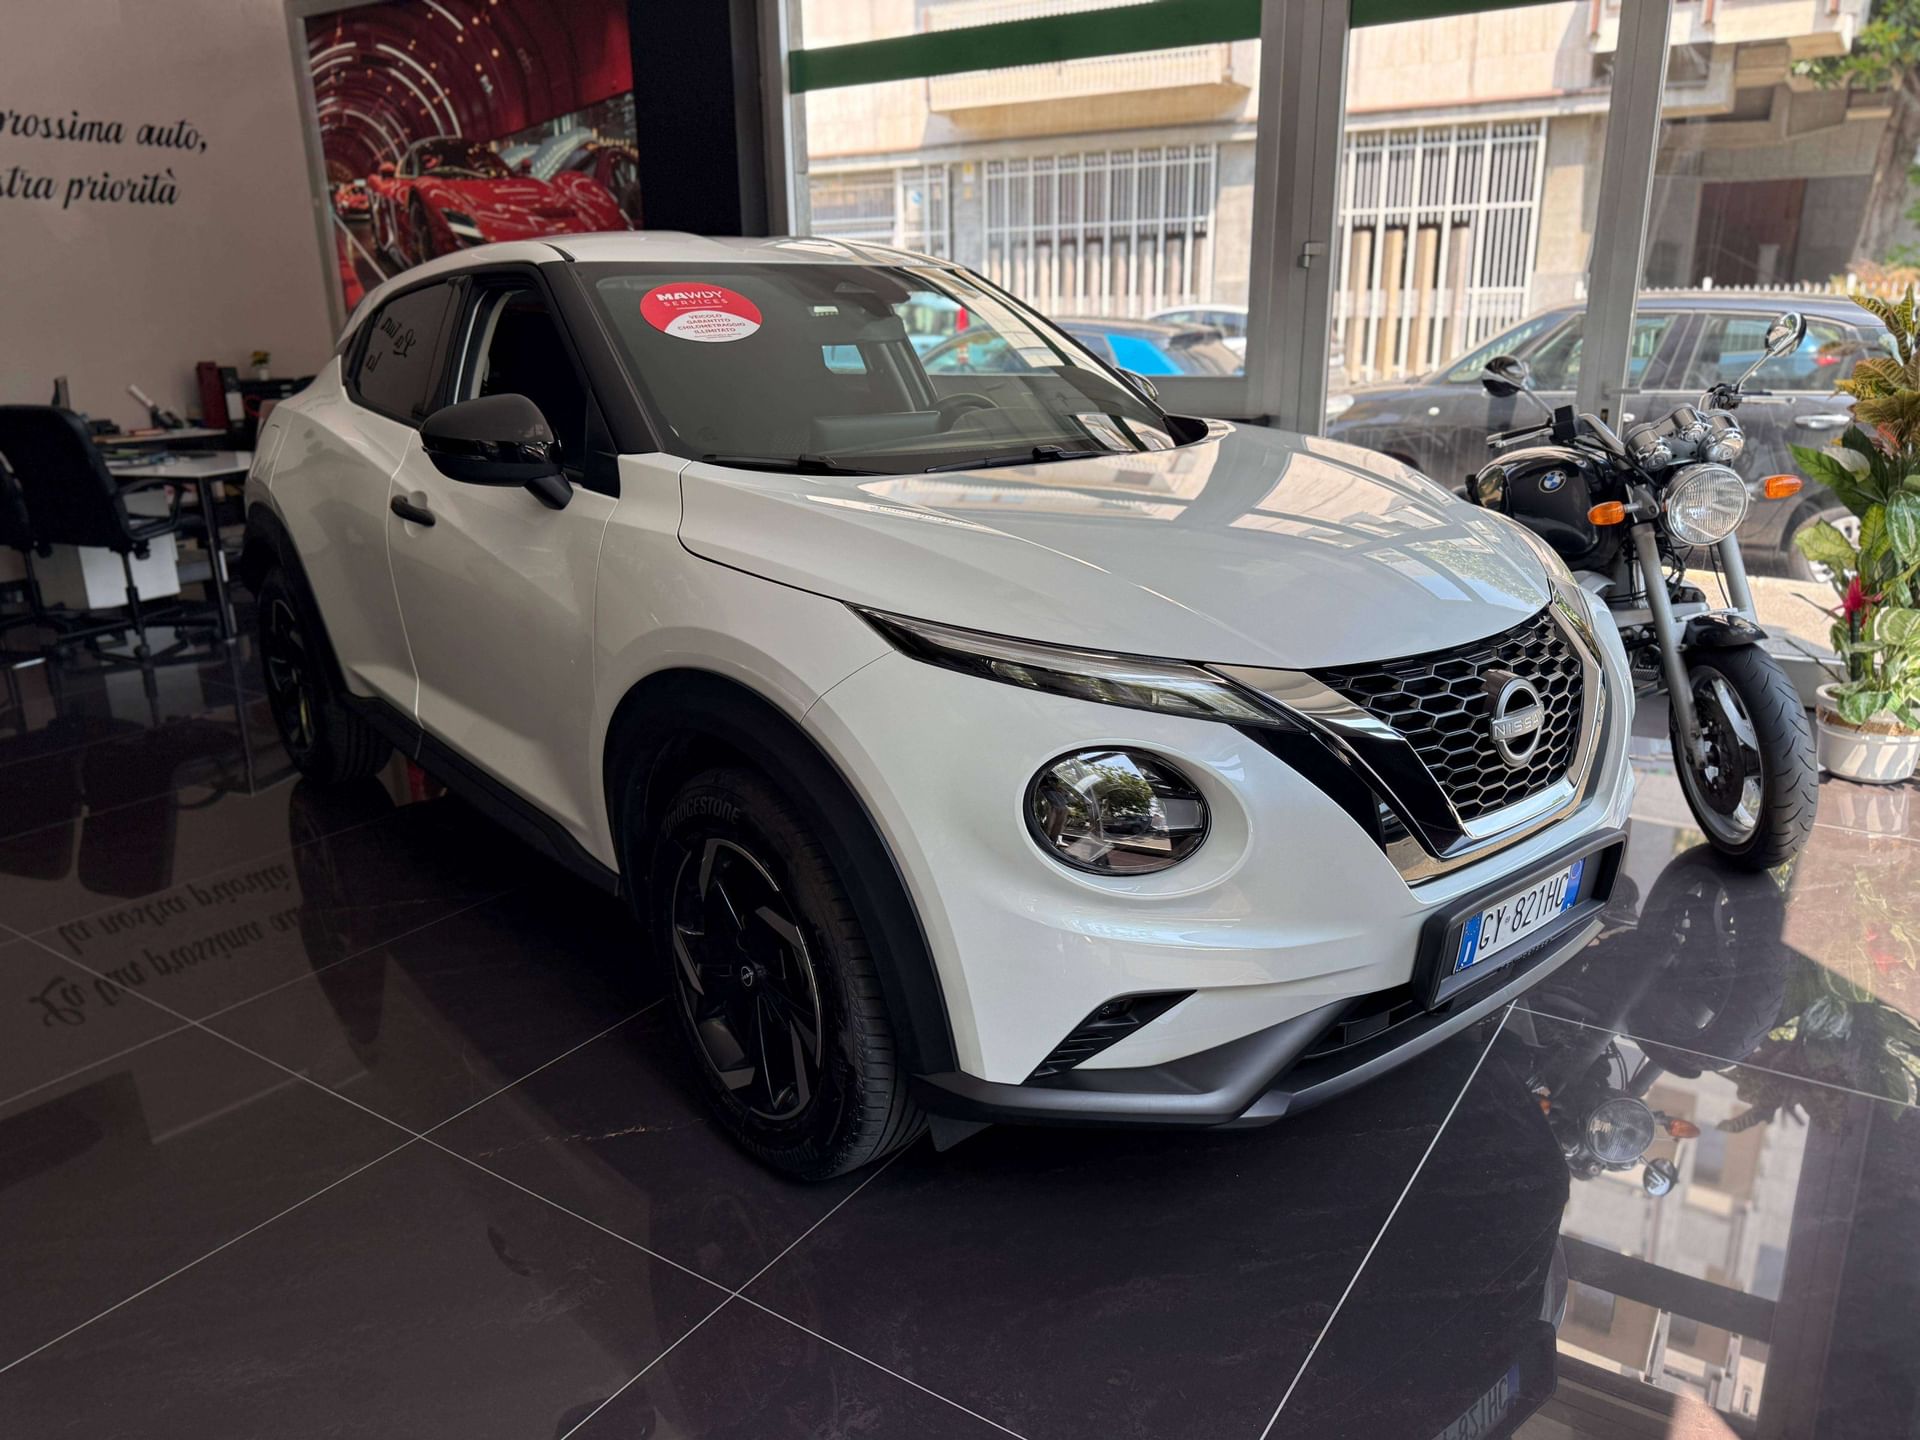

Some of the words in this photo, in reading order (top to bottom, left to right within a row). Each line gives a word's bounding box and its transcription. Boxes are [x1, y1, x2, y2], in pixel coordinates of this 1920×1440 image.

[137, 118, 207, 154] auto,
[62, 167, 179, 210] priorità
[656, 291, 722, 301] MAWDY
[663, 298, 729, 307] SERVICES
[677, 322, 746, 330] CHILOMETRAGGIO
[1479, 904, 1507, 950] GY
[1512, 872, 1569, 932] 821HC
